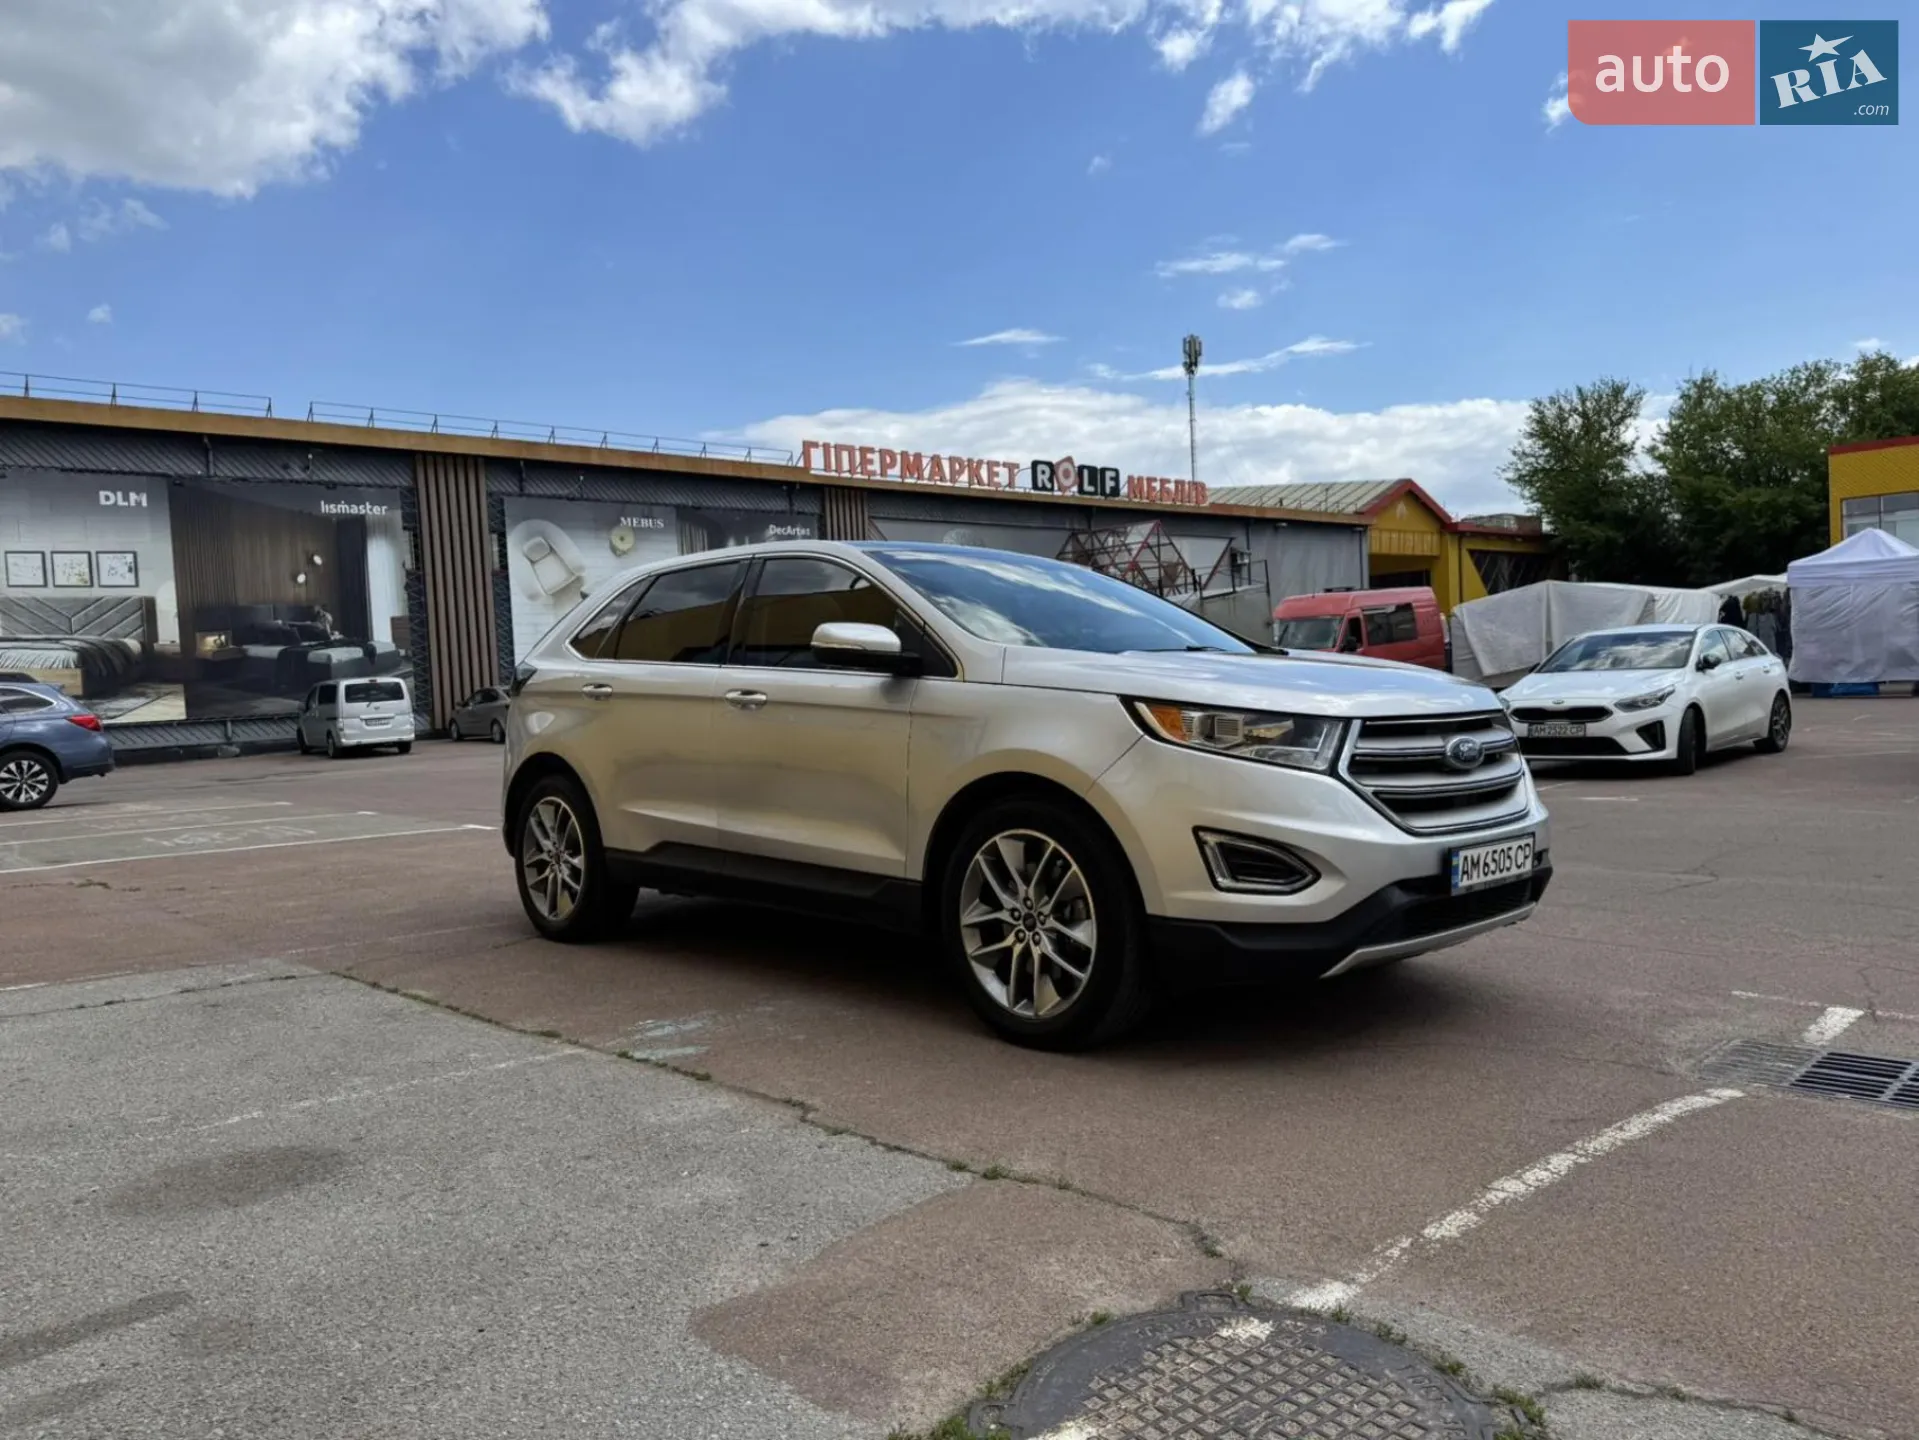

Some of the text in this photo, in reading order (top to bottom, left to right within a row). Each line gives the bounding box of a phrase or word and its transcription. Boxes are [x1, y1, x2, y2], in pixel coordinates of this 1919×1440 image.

[802, 440, 1208, 505] ГІПЕРМАРКЕТ ROLF МЕБЛІВ
[99, 490, 148, 507] DLM
[620, 516, 665, 529] MEBUS
